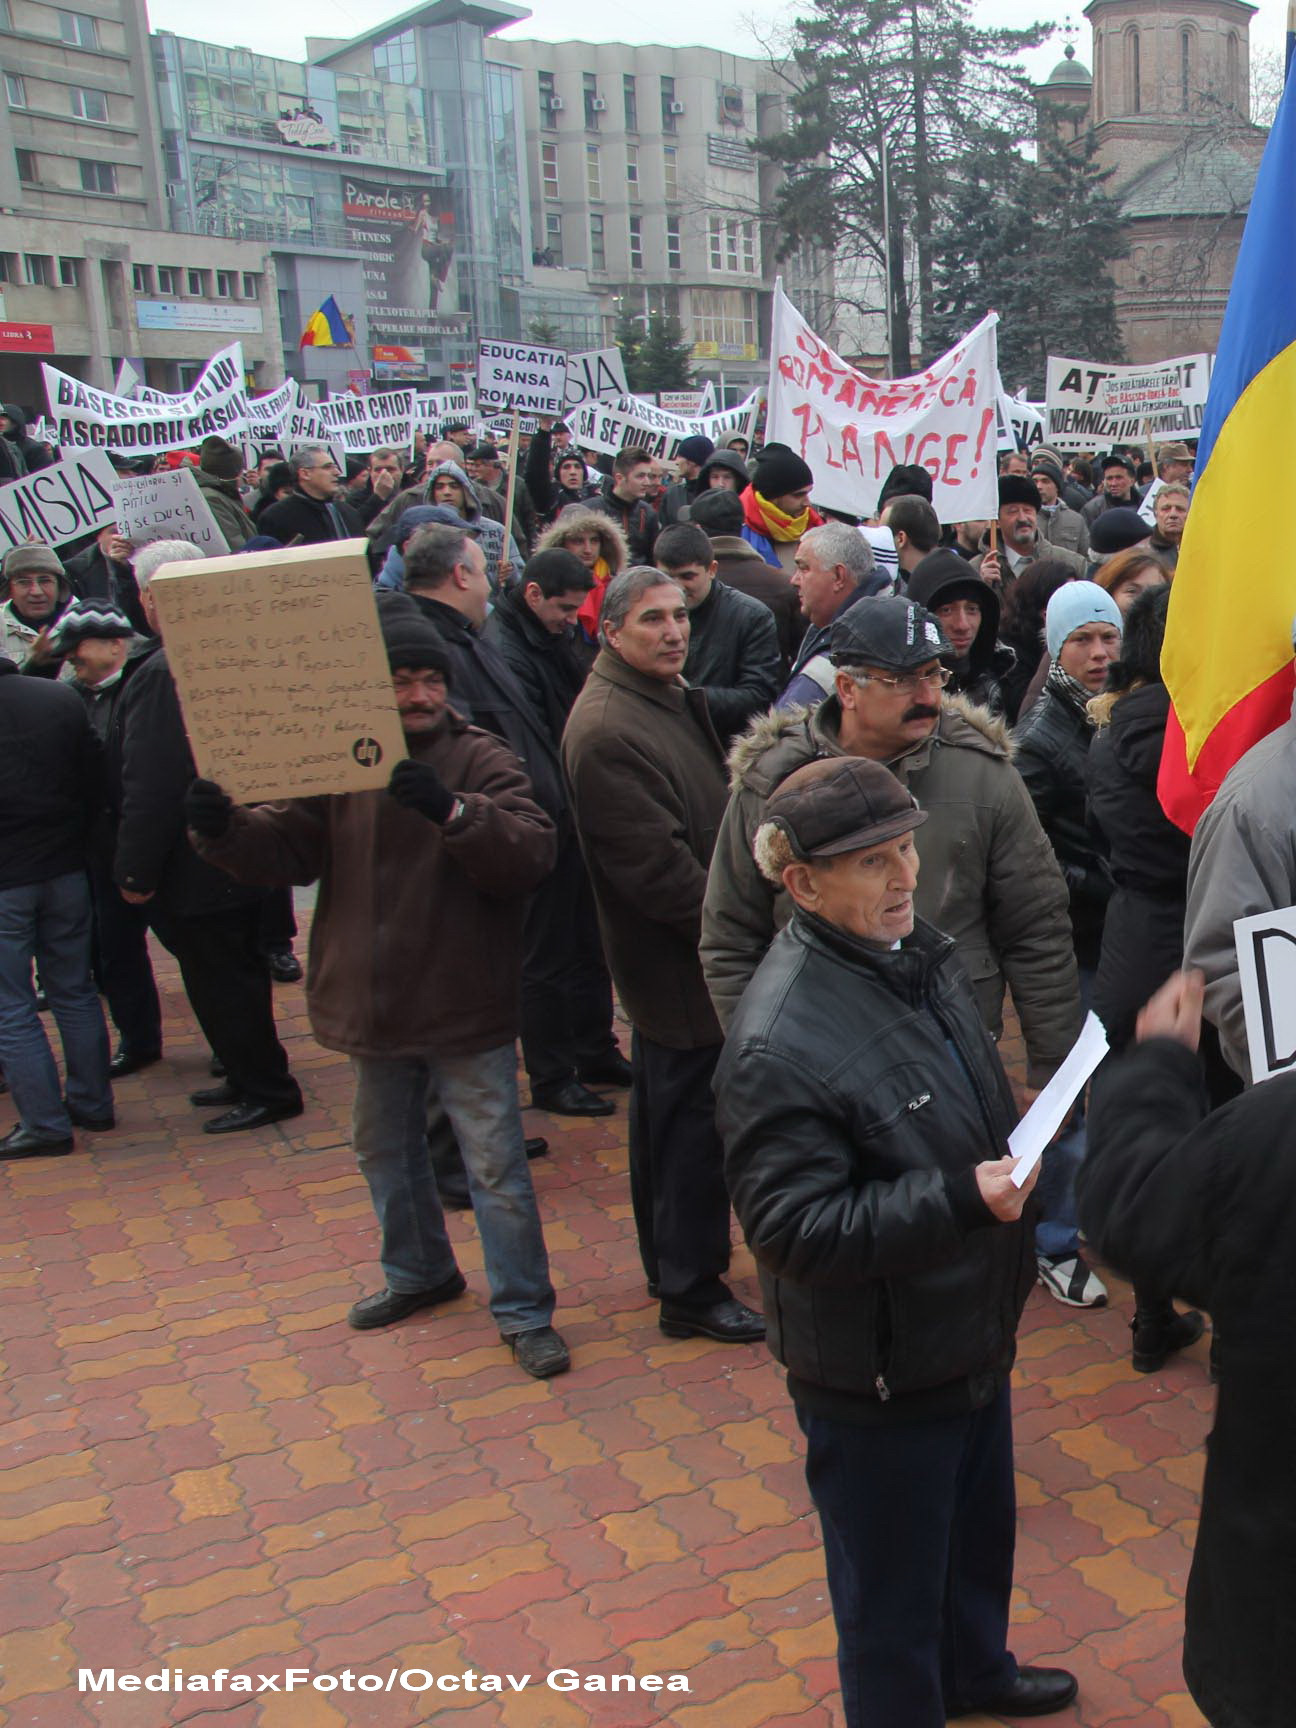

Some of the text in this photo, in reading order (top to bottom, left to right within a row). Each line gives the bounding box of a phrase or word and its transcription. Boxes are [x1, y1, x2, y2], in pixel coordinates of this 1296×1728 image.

[480, 343, 567, 368] EDUCATIA
[57, 377, 162, 419] BĂSESCU
[212, 357, 241, 393] LUI
[492, 368, 550, 388] SANSA
[567, 355, 623, 404] SIA
[1058, 367, 1117, 405] AȚ
[478, 387, 563, 412] ROMANIEI
[60, 418, 184, 448] ASCADORII
[369, 427, 383, 446] DE
[579, 407, 596, 441] SĂ
[599, 416, 623, 446] SE
[122, 492, 159, 512] PITICU
[135, 516, 150, 529] SE
